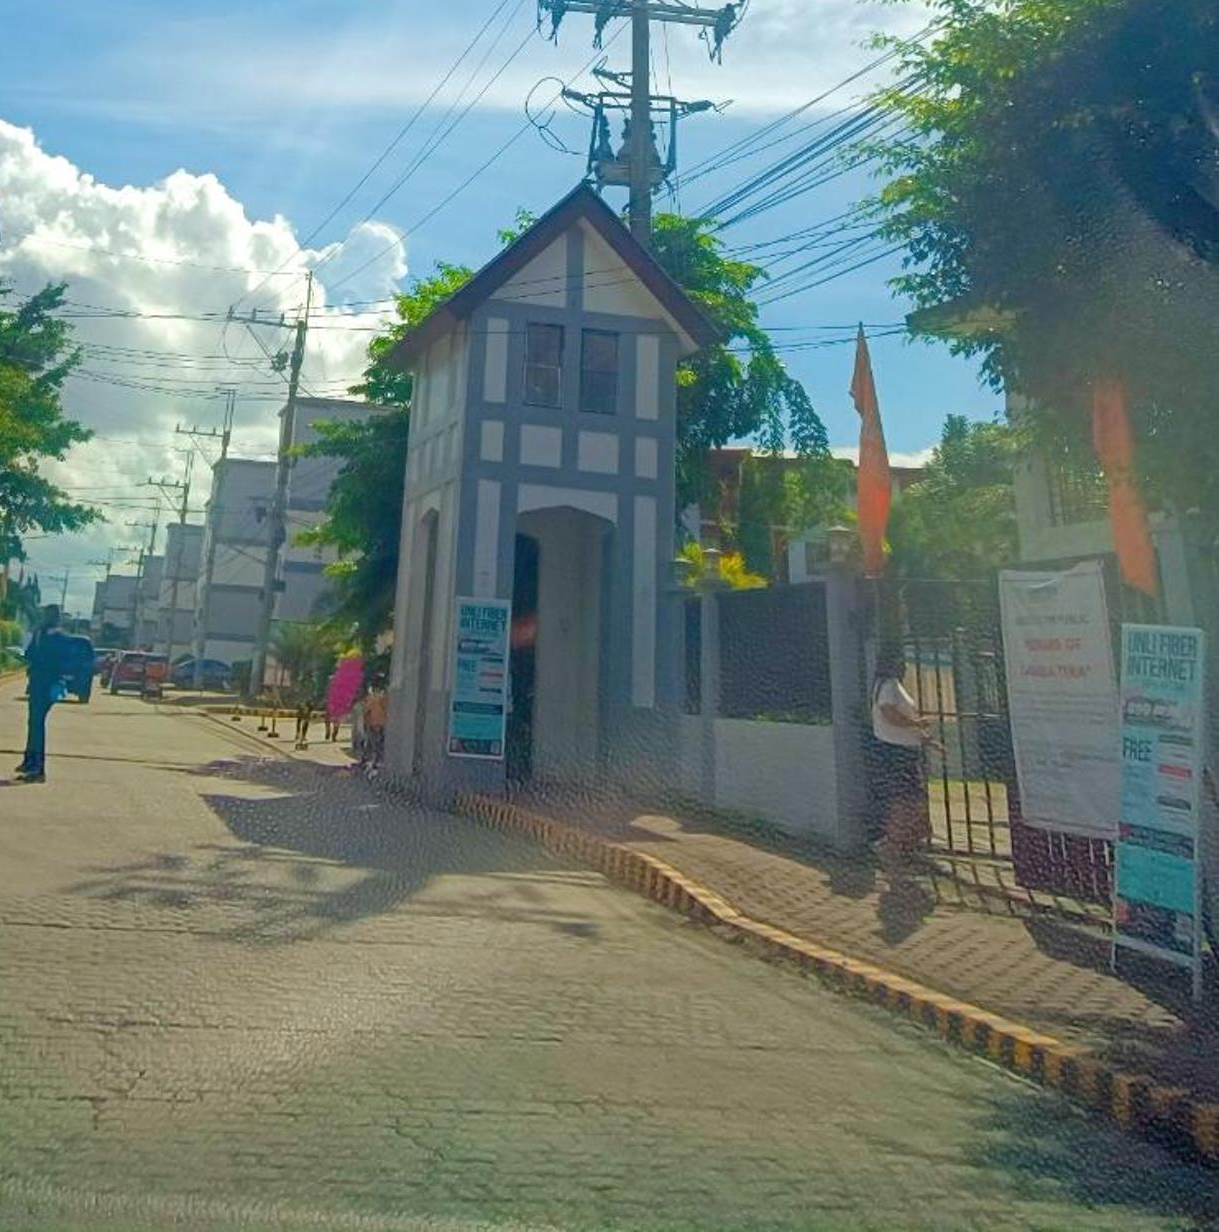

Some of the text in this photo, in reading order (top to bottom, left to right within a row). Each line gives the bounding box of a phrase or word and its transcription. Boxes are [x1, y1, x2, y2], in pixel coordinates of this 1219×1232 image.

[1128, 631, 1198, 657] UNLI FIBER
[1127, 655, 1197, 681] INTERNET
[1122, 736, 1153, 762] FREE
